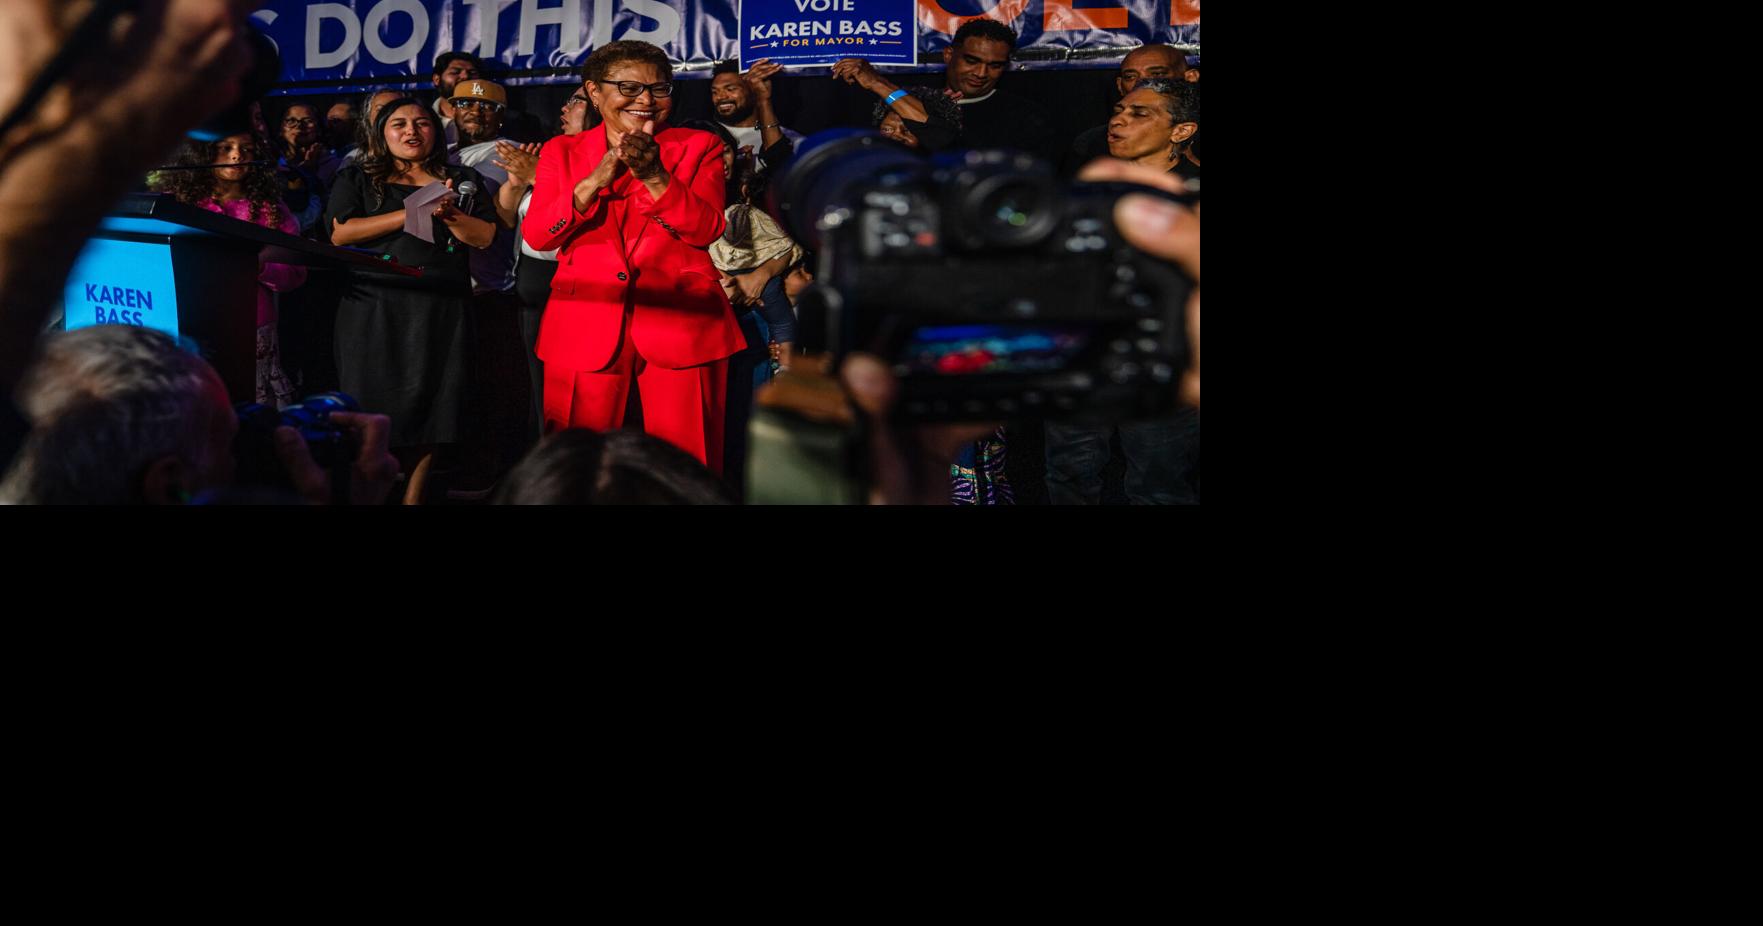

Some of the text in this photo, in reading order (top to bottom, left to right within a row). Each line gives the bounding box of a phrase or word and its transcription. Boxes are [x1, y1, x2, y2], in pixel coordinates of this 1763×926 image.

[305, 0, 430, 69] DO
[750, 20, 903, 41] KAREN BASS
[783, 37, 864, 47] FOR MAYOR
[471, 82, 484, 96] LA
[85, 283, 153, 327] KAREN BASS
